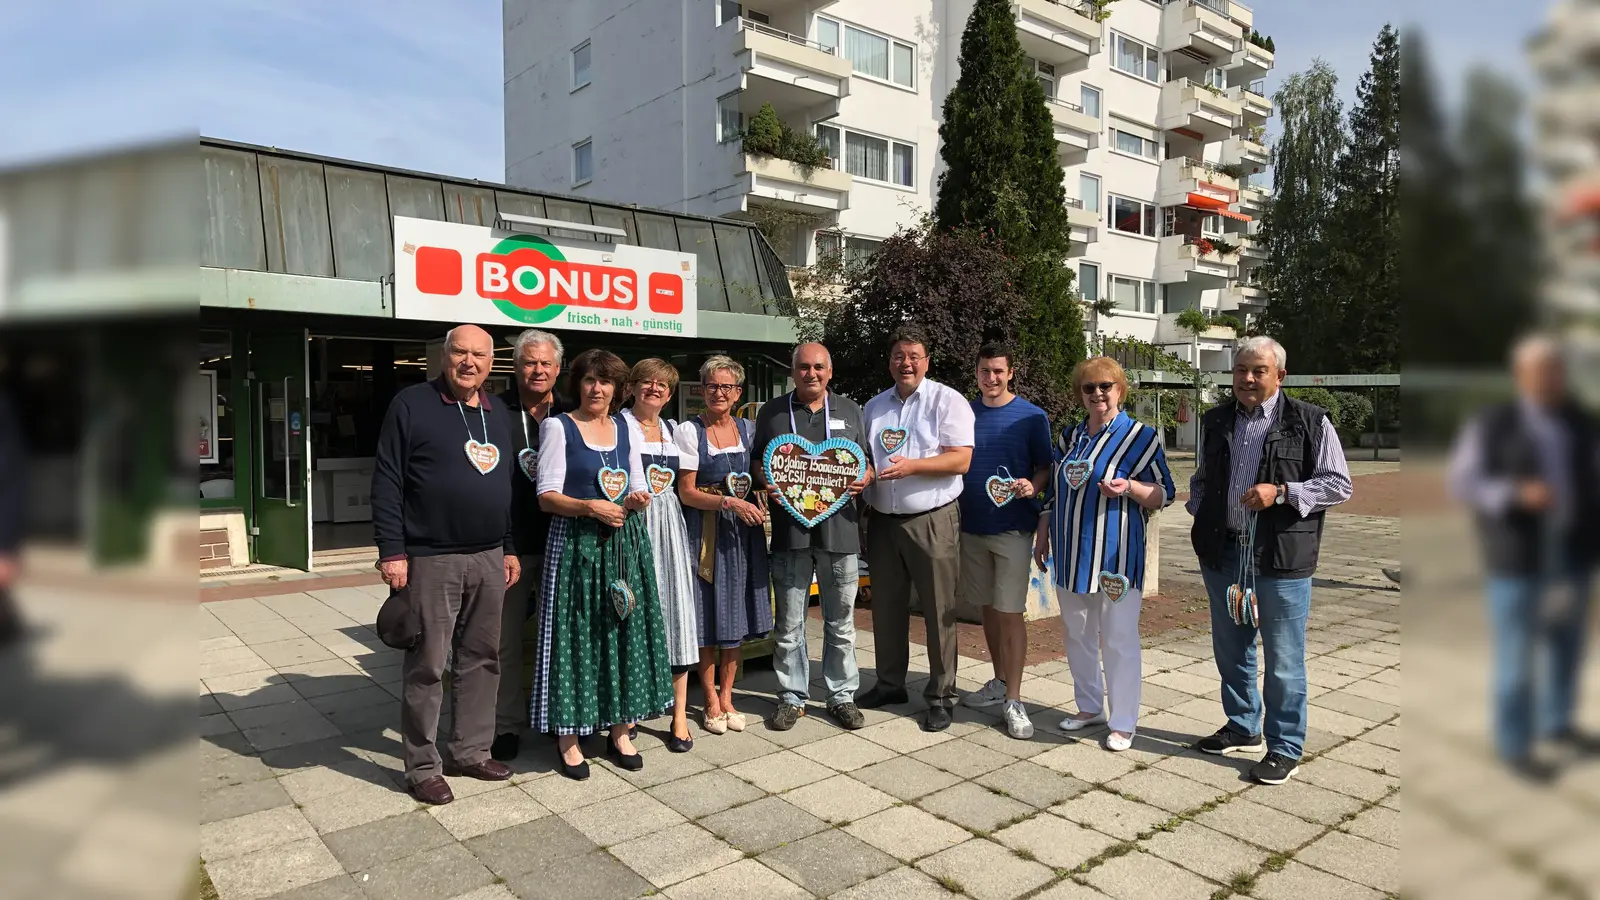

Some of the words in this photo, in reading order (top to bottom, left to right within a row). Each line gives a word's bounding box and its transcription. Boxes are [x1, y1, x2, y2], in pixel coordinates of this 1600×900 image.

[482, 261, 634, 304] BONUS
[567, 312, 601, 325] frisch
[611, 317, 633, 327] nah
[643, 319, 683, 333] günstig
[784, 455, 808, 473] Jahre
[773, 471, 788, 482] Die
[788, 469, 806, 484] CSU
